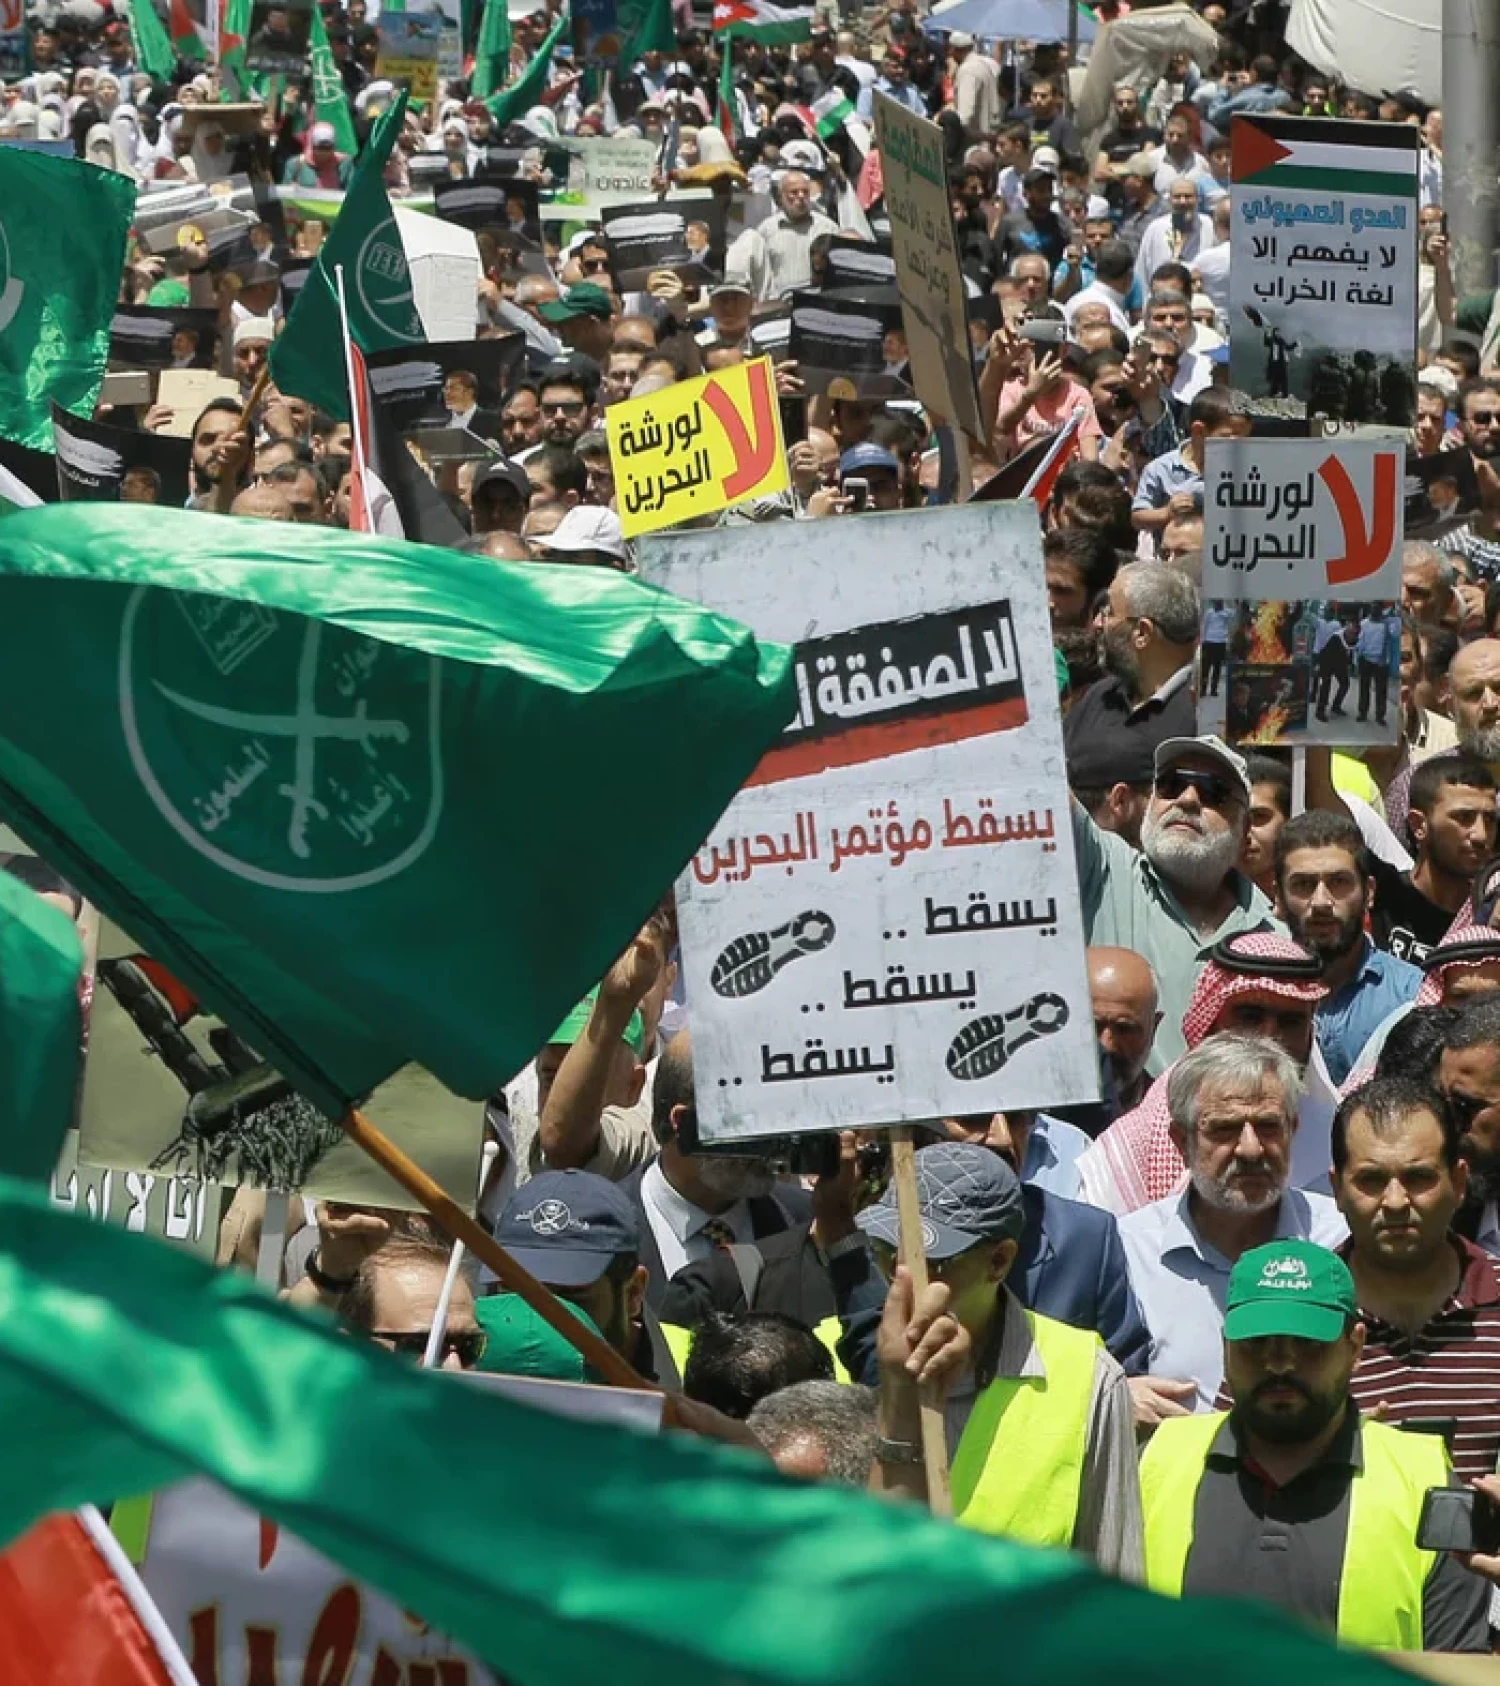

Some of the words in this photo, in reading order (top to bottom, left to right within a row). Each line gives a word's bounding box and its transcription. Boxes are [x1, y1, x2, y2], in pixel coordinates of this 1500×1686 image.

[1241, 195, 1344, 227] الصهيوني
[1350, 205, 1406, 234] العدو
[1252, 236, 1276, 264] إلا
[1287, 241, 1369, 271] يفهم
[1379, 245, 1396, 268] لا
[1253, 276, 1336, 305] الخراب
[1346, 282, 1393, 306] لغة
[619, 400, 702, 457] لورشة
[701, 361, 776, 501] لا
[625, 448, 712, 513] البحرين
[1216, 465, 1314, 520] لورشة
[1317, 453, 1396, 585] لا
[1212, 523, 1315, 572] البحرين
[816, 624, 980, 719] لصفقة
[983, 616, 1018, 686] لا
[693, 811, 818, 885] البحرين
[829, 801, 932, 873] مؤتمر
[942, 798, 1057, 853] يسقط
[925, 892, 1058, 937] يسقط
[843, 965, 976, 1010] يسقط
[760, 1039, 894, 1084] يسقط
